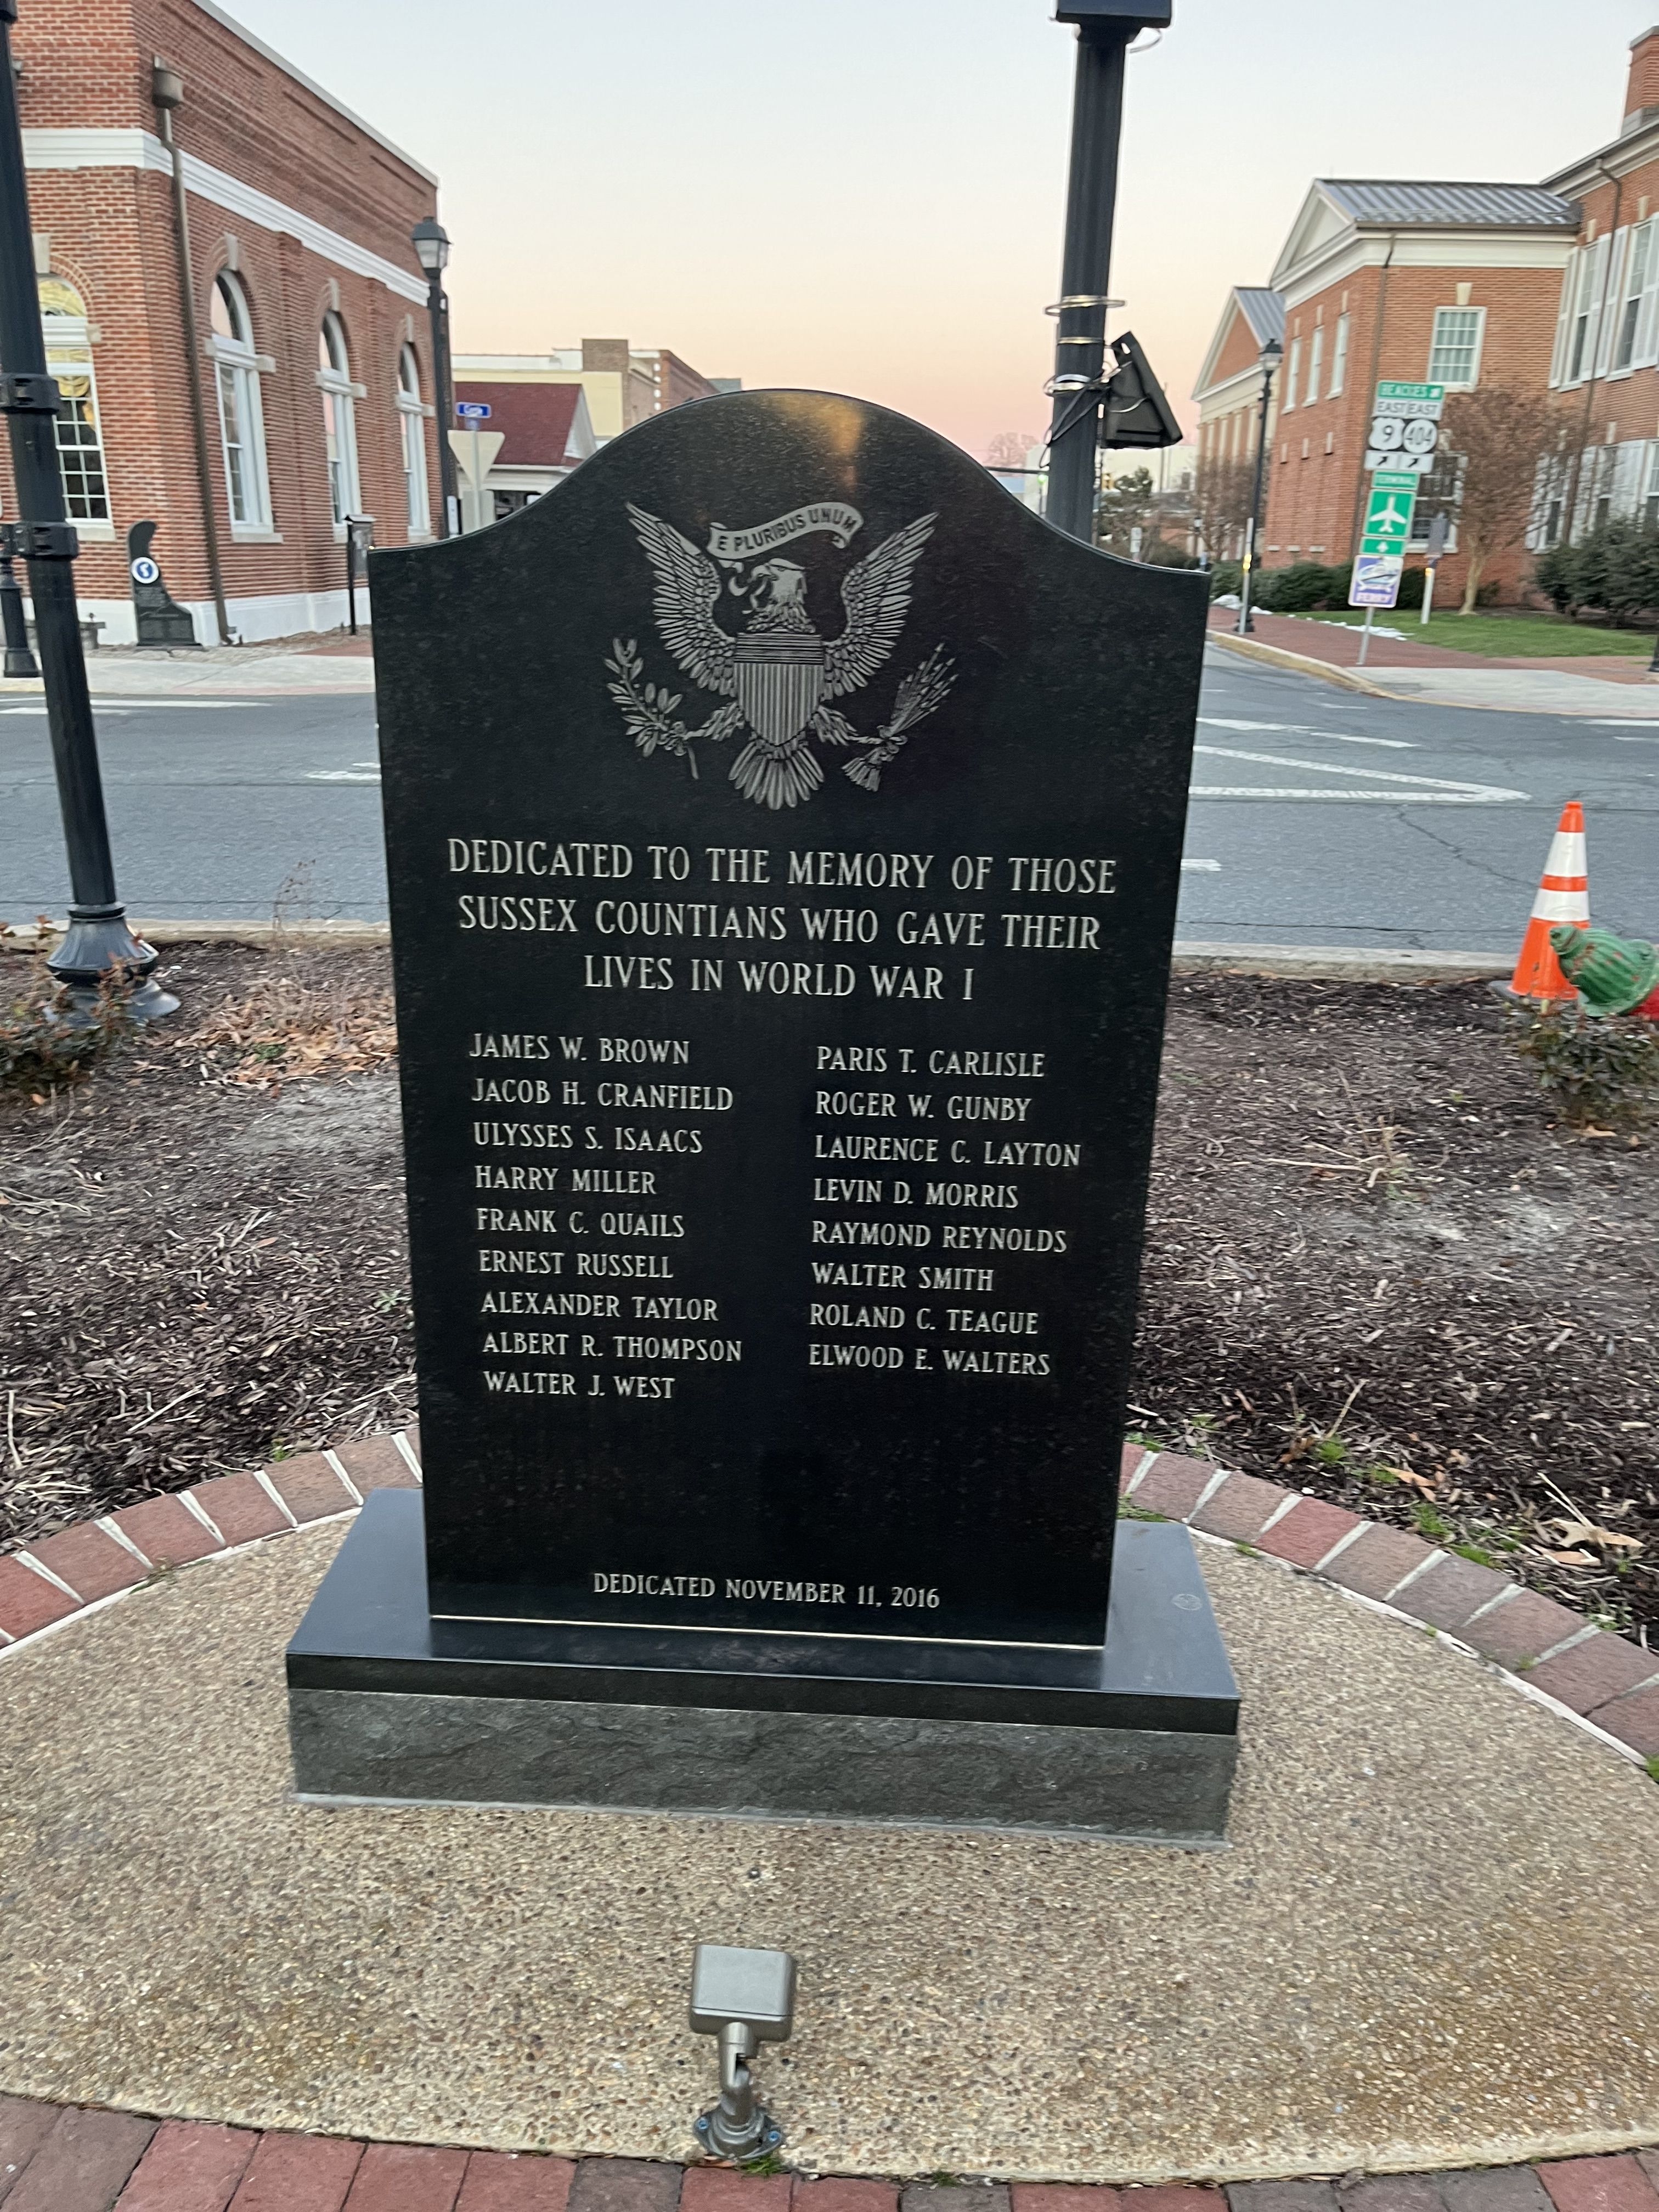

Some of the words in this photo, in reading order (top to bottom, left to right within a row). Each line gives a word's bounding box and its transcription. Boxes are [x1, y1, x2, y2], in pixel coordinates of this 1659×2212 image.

[1378, 401, 1406, 413] EAST
[1408, 403, 1437, 415] EAST
[1383, 425, 1394, 443] 9
[1406, 427, 1433, 445] 404
[718, 535, 729, 551] E
[733, 514, 806, 551] PLURIBUS
[808, 508, 857, 534] UNUM
[447, 838, 633, 878] DEDICATED
[647, 845, 690, 881] TO
[706, 848, 770, 883] THE
[787, 851, 934, 888] MEMORY
[951, 855, 993, 890] OF
[1008, 857, 1116, 894] THOSE
[459, 895, 578, 932] SUSSEX
[596, 900, 787, 940] COUNTIANS
[800, 908, 878, 943] WHO
[897, 911, 985, 946] GAVE
[1001, 914, 1101, 950] THEIR
[584, 955, 674, 990] LIVES
[691, 959, 724, 991] IN
[737, 961, 855, 996] WORLD
[868, 965, 944, 1000] WAR
[962, 968, 974, 1000] I
[469, 1033, 550, 1059] JAMES
[558, 1036, 587, 1061] W.
[599, 1038, 690, 1064] BROWN
[816, 1046, 887, 1072] PARIS
[898, 1048, 917, 1073] T.
[929, 1050, 1045, 1077] CARLISLE
[472, 1078, 550, 1104] JACOB
[561, 1081, 586, 1105] H.
[597, 1082, 733, 1110] CRANFIELD
[816, 1091, 897, 1117] ROGER
[907, 1094, 934, 1118] W.
[947, 1096, 1032, 1121] GUNBY
[473, 1122, 573, 1148] ULYSSES
[585, 1126, 603, 1149] S.
[615, 1127, 702, 1153] ISAACS
[815, 1135, 939, 1162] LAURENCE
[951, 1140, 971, 1164] C.
[984, 1141, 1081, 1167] LAYTON
[475, 1165, 558, 1190] HARRY
[571, 1169, 657, 1194] MILLER
[814, 1178, 882, 1203] LEVIN
[893, 1181, 913, 1204] D.
[925, 1182, 1018, 1209] MORRIS
[476, 1207, 557, 1233] FRANK
[569, 1211, 589, 1234] C.
[601, 1212, 685, 1238] QUAILS
[812, 1220, 931, 1247] RAYMOND
[942, 1226, 1067, 1252] REYNOLDS
[478, 1250, 565, 1274] ERNEST
[577, 1253, 674, 1278] RUSSELL
[811, 1262, 907, 1288] WALTER
[918, 1267, 994, 1291] SMITH
[481, 1291, 620, 1317] ALEXANDER
[631, 1296, 719, 1321] TAYLOR
[809, 1304, 905, 1328] ROLAND
[916, 1308, 936, 1330] C.
[946, 1309, 1039, 1334] TEAGUE
[482, 1331, 569, 1355] ALBERT
[581, 1335, 603, 1357] R.
[612, 1336, 742, 1362] THOMPSON
[809, 1344, 904, 1368] ELWOOD
[915, 1348, 933, 1370] E.
[942, 1350, 1050, 1375] WALTERS
[483, 1370, 577, 1395] WALTER
[588, 1375, 605, 1396] J.
[613, 1376, 675, 1398] WEST
[594, 1573, 715, 1597] DEDICATED
[725, 1579, 846, 1604] NOVEMBER
[857, 1585, 882, 1607] 11,
[890, 1587, 940, 1608] 2016
